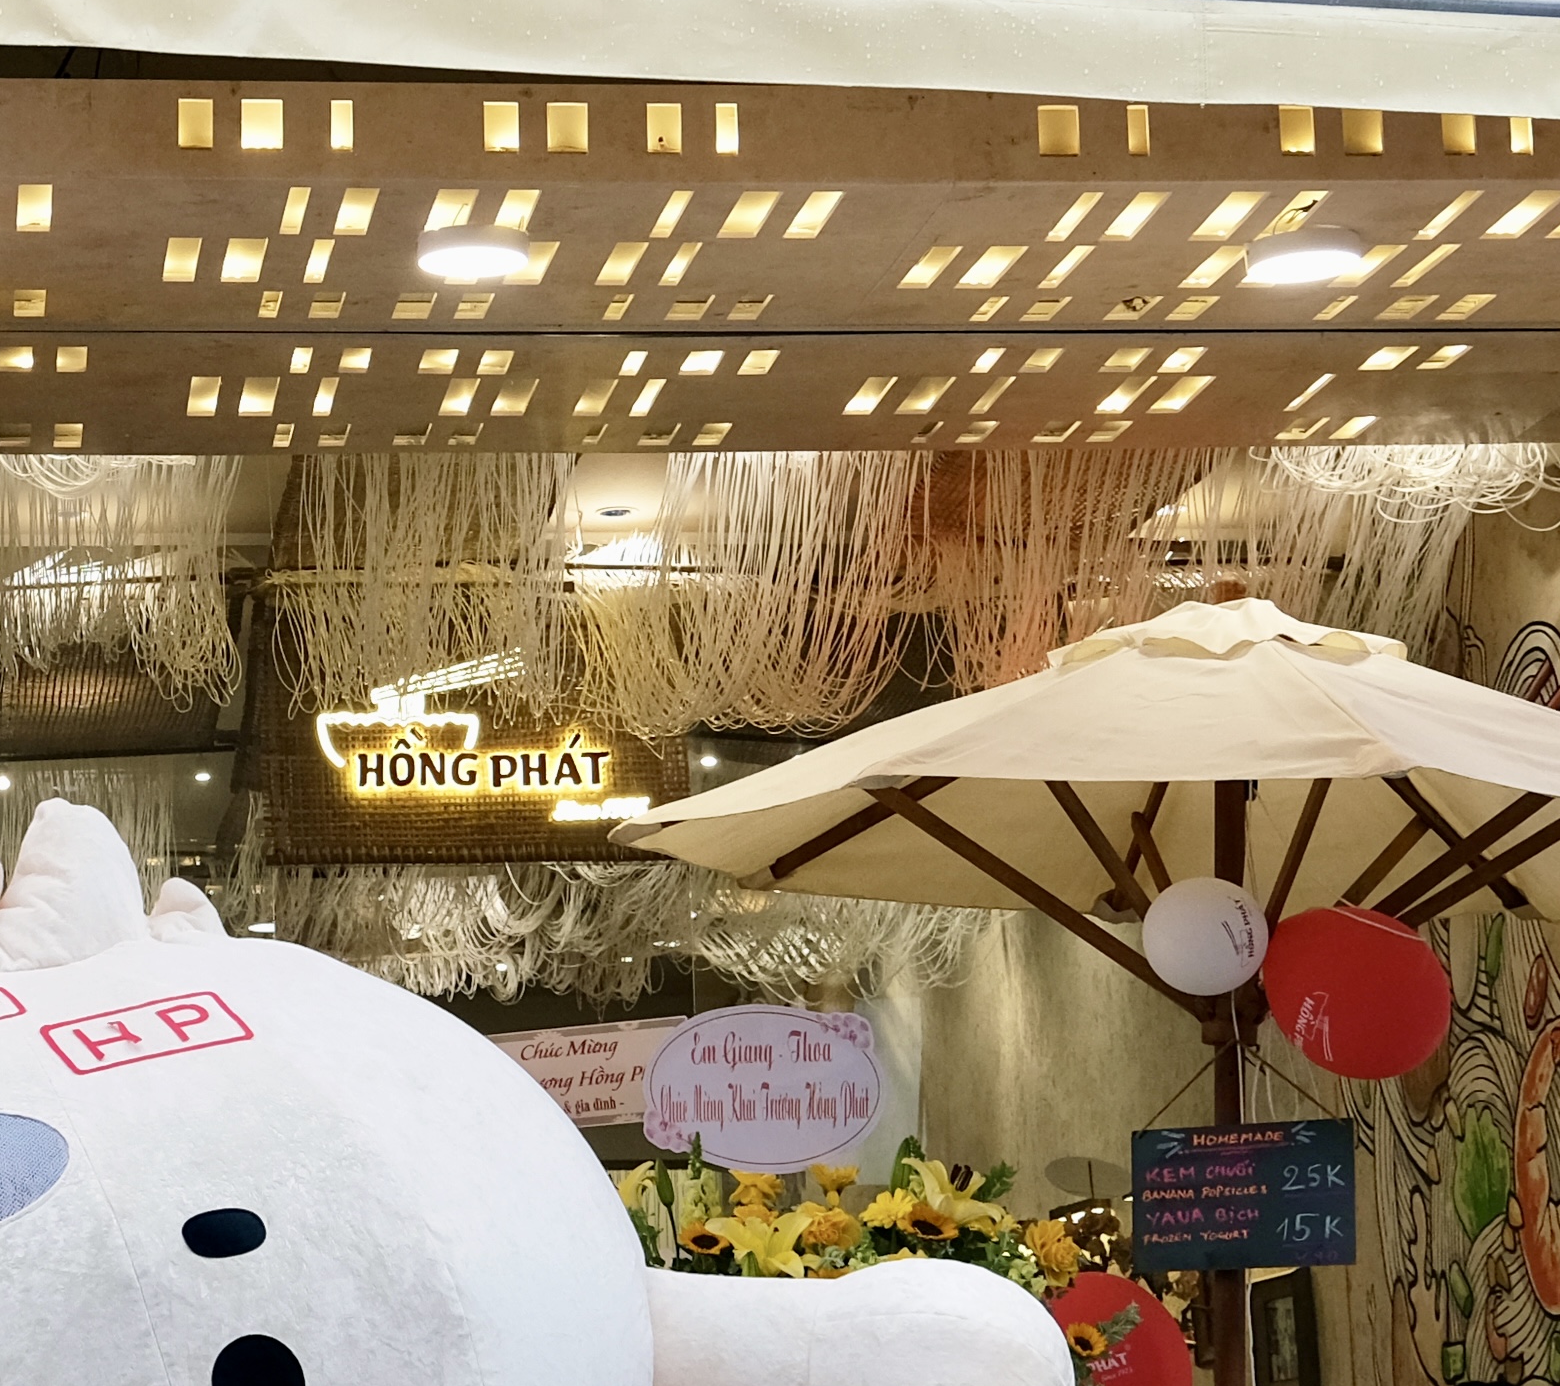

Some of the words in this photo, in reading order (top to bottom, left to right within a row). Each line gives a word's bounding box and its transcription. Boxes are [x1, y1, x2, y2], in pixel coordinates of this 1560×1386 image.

[357, 726, 479, 787] HỒNG
[489, 732, 611, 788] PHÁT
[72, 1003, 211, 1062] HP
[519, 1039, 563, 1062] Chúc
[566, 1037, 619, 1063] Mừng
[691, 1031, 717, 1065] Em
[722, 1031, 774, 1071] Giang
[787, 1029, 833, 1064] Thoa
[578, 1066, 625, 1091] Hồng
[574, 1099, 592, 1115] gia
[1192, 1130, 1285, 1147] HOMEMADE
[1145, 1165, 1196, 1183] KEM
[1142, 1188, 1196, 1202] BANANA
